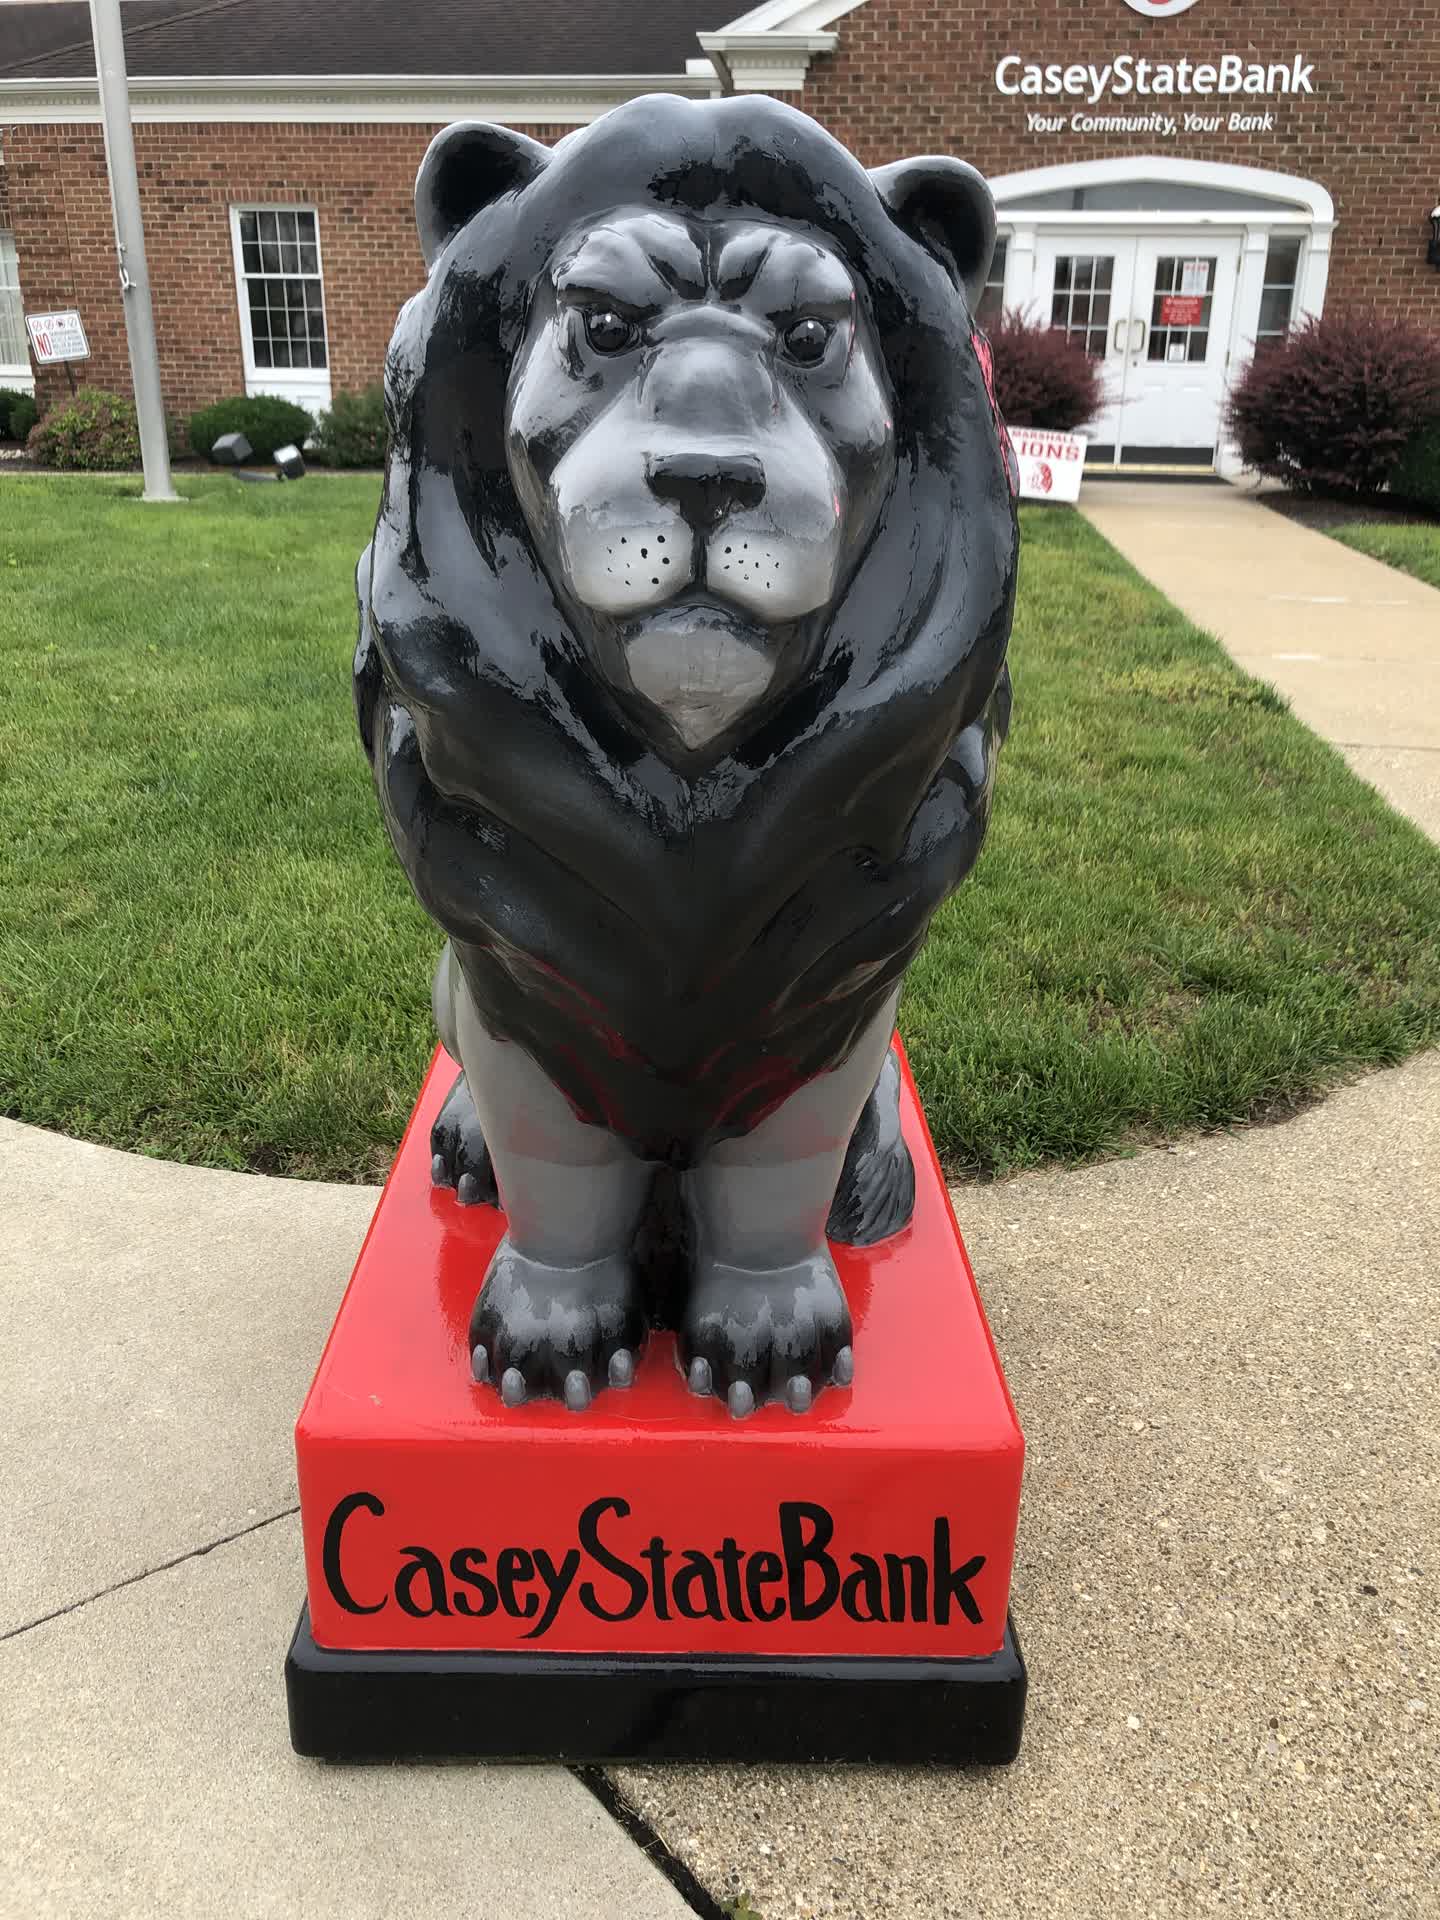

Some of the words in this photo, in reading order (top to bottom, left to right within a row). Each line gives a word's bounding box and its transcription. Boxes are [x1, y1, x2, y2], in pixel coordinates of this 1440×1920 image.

[995, 54, 1315, 104] CaseyStateBank
[1027, 112, 1066, 132] Your
[1071, 112, 1177, 136] Community,
[1183, 112, 1224, 132] Your
[1228, 112, 1274, 132] Bank
[36, 332, 53, 357] NO
[1012, 430, 1075, 442] MARSHALL
[1016, 440, 1080, 461] IONS
[323, 1491, 986, 1638] CaseyStateBank
